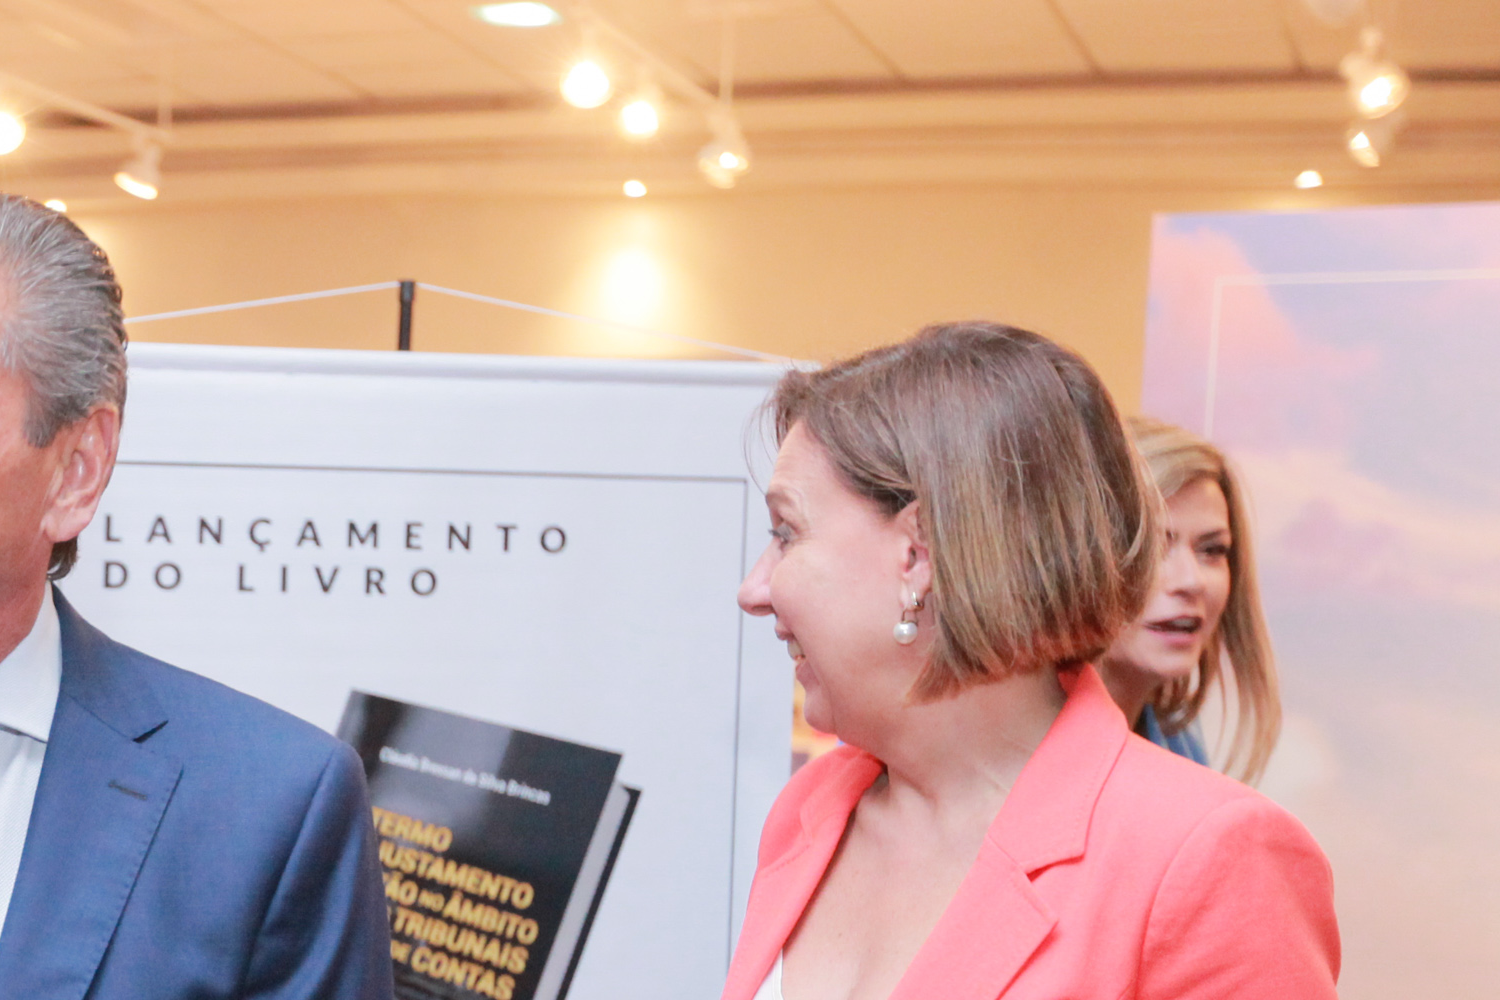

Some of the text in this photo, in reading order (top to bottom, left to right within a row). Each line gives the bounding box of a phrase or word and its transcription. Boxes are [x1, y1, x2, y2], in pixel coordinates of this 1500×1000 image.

[103, 513, 568, 555] LANÇAMENTO
[103, 560, 438, 597] DO LIVRO
[394, 906, 530, 975] TRIBUNAIS
[442, 889, 539, 946] ÂMBITO
